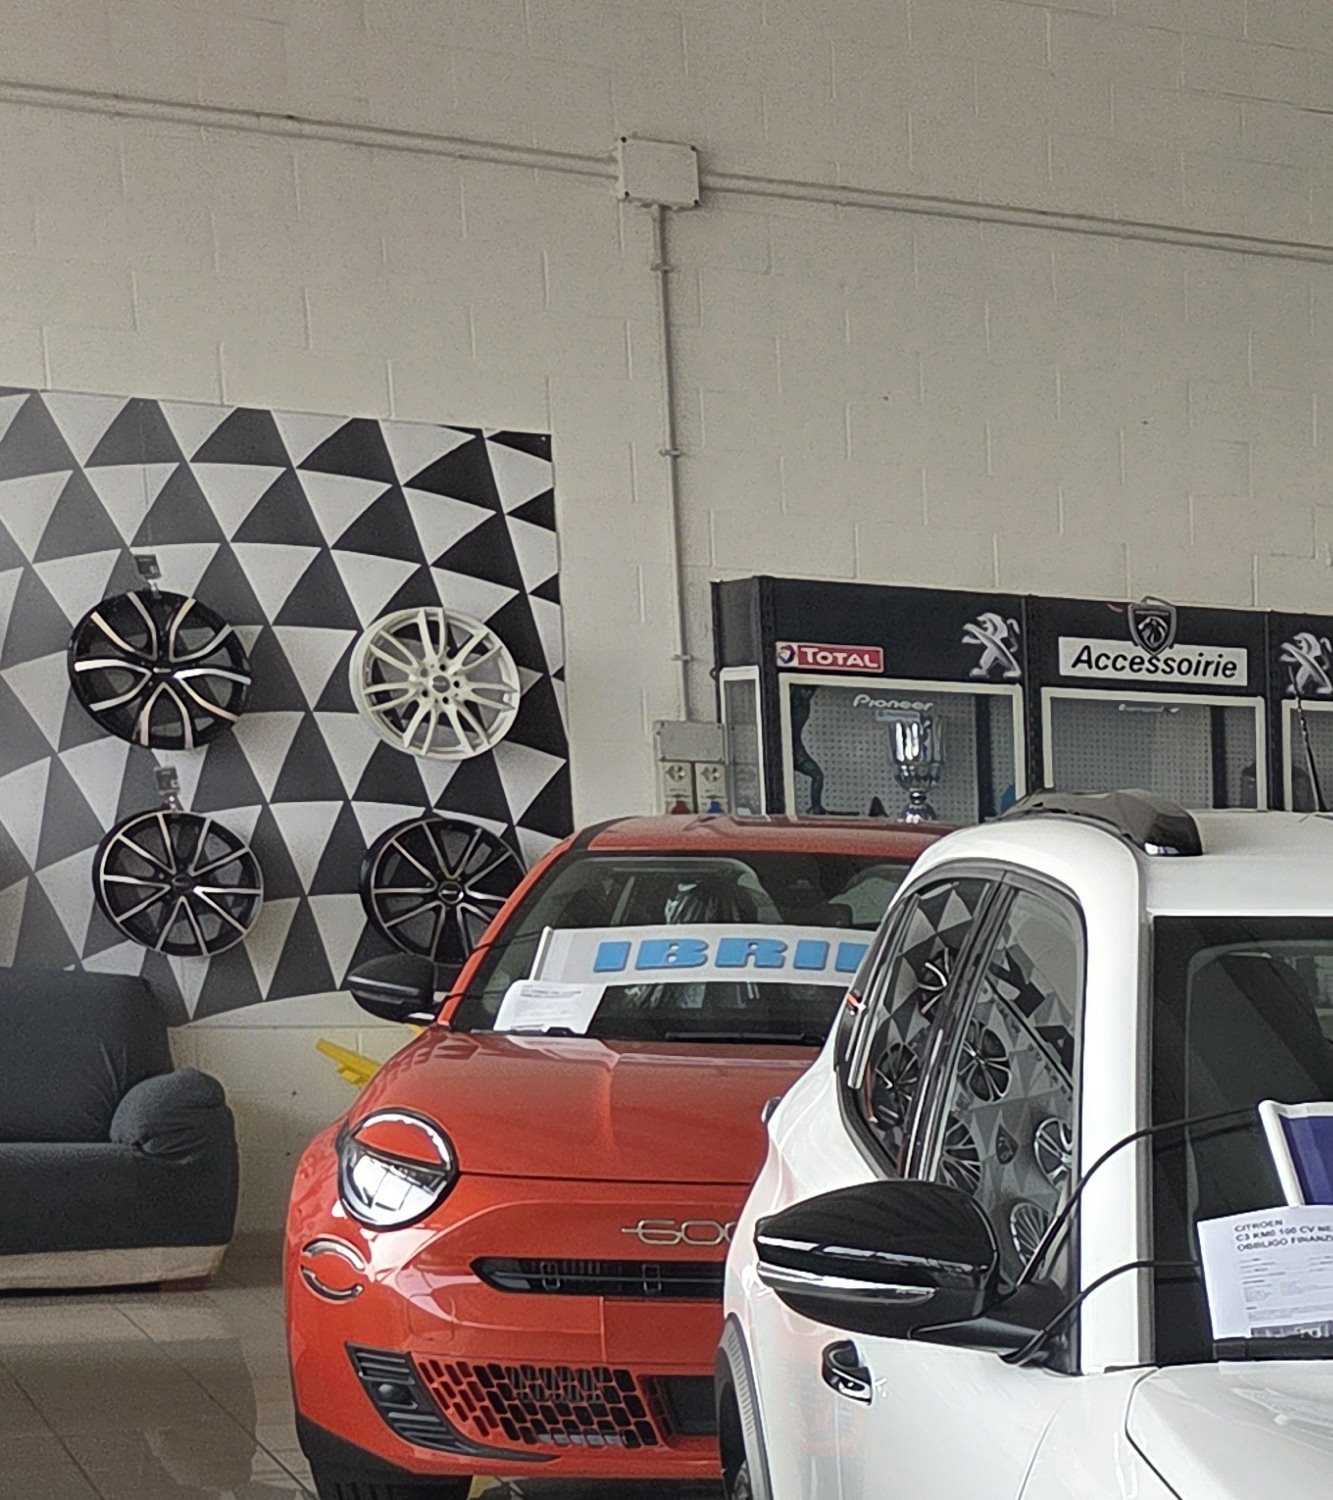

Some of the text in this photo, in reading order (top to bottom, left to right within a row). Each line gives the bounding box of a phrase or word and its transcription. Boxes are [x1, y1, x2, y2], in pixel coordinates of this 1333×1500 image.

[800, 647, 879, 668] TOTAL
[1071, 645, 1237, 678] Accessoirie
[853, 694, 934, 711] Pioneer
[1234, 1219, 1284, 1232] CITROEN
[1236, 1233, 1250, 1243] C3
[1299, 1226, 1315, 1234] CV
